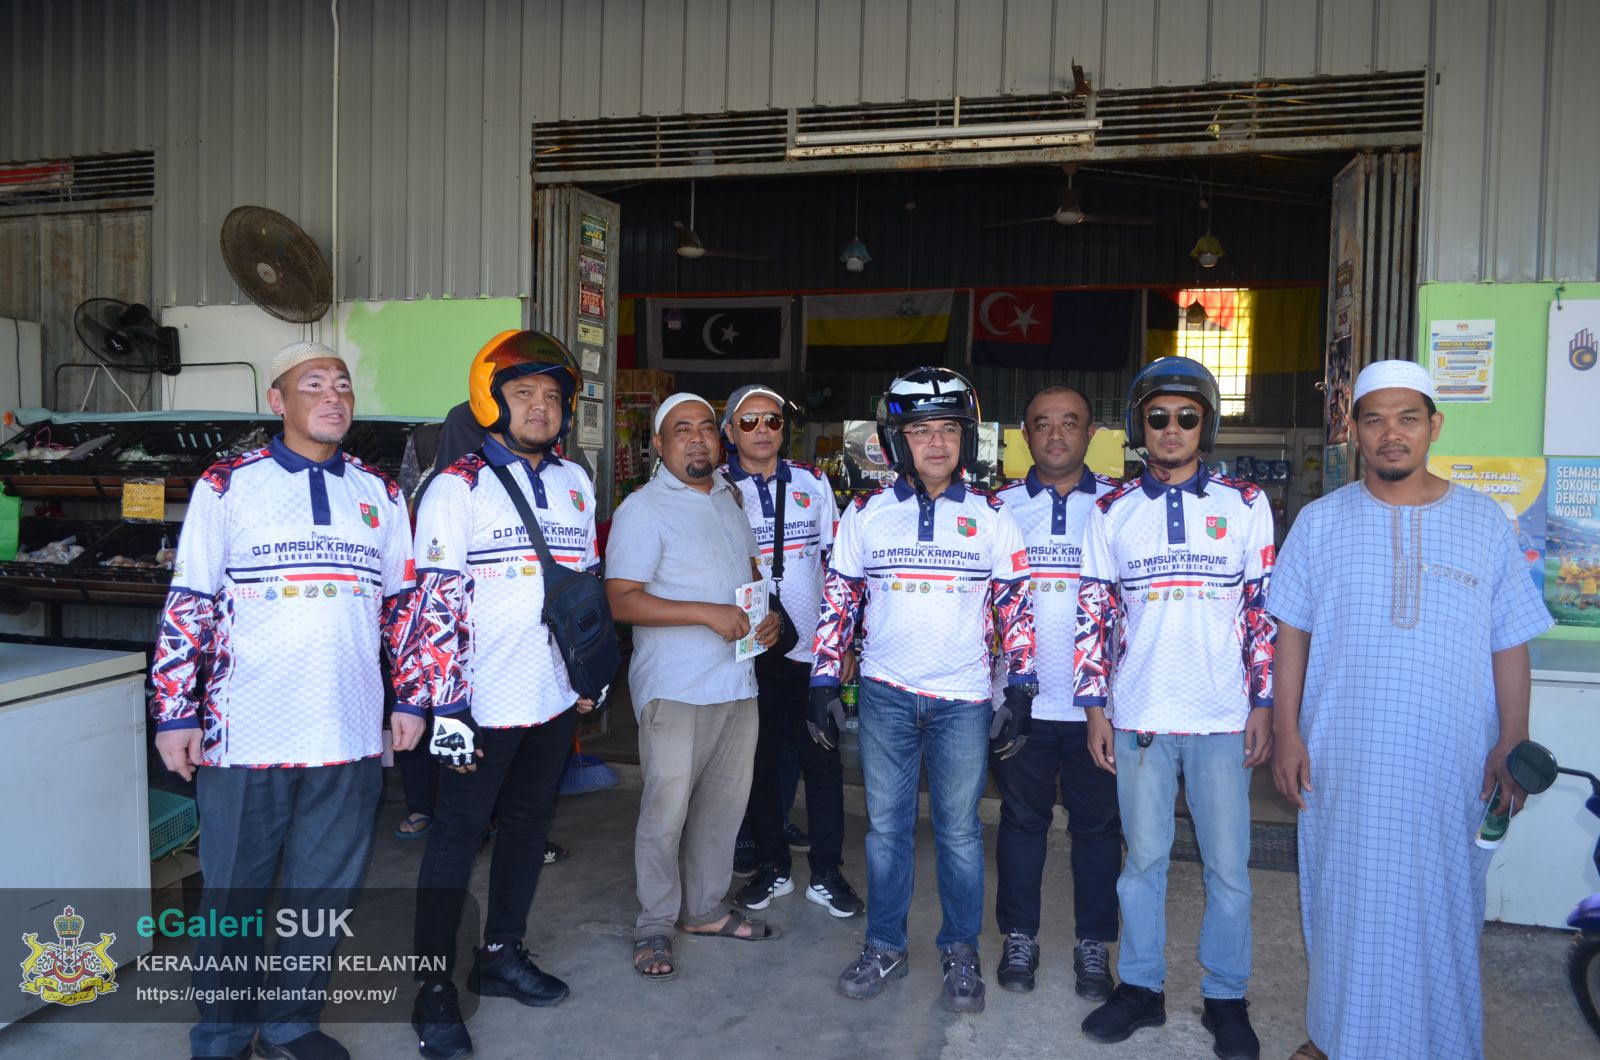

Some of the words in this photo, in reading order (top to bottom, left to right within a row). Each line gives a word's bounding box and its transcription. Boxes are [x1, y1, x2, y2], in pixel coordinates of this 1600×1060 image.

[861, 470, 896, 480] PEPS
[1451, 471, 1479, 480] RASA
[1480, 471, 1498, 480] TEH
[1555, 492, 1597, 505] DENGAN
[1555, 504, 1592, 518] WONDA
[551, 526, 588, 538] KAMPU
[752, 525, 775, 535] ASUK
[783, 520, 817, 530] AMPUNG
[311, 531, 341, 543] Program
[274, 540, 324, 553] MASUK
[915, 541, 939, 551] Program
[887, 547, 925, 557] MASUK
[927, 549, 980, 561] KAMPUNG
[1143, 554, 1178, 567] MASUK
[1180, 554, 1228, 565] KAMPUNG
